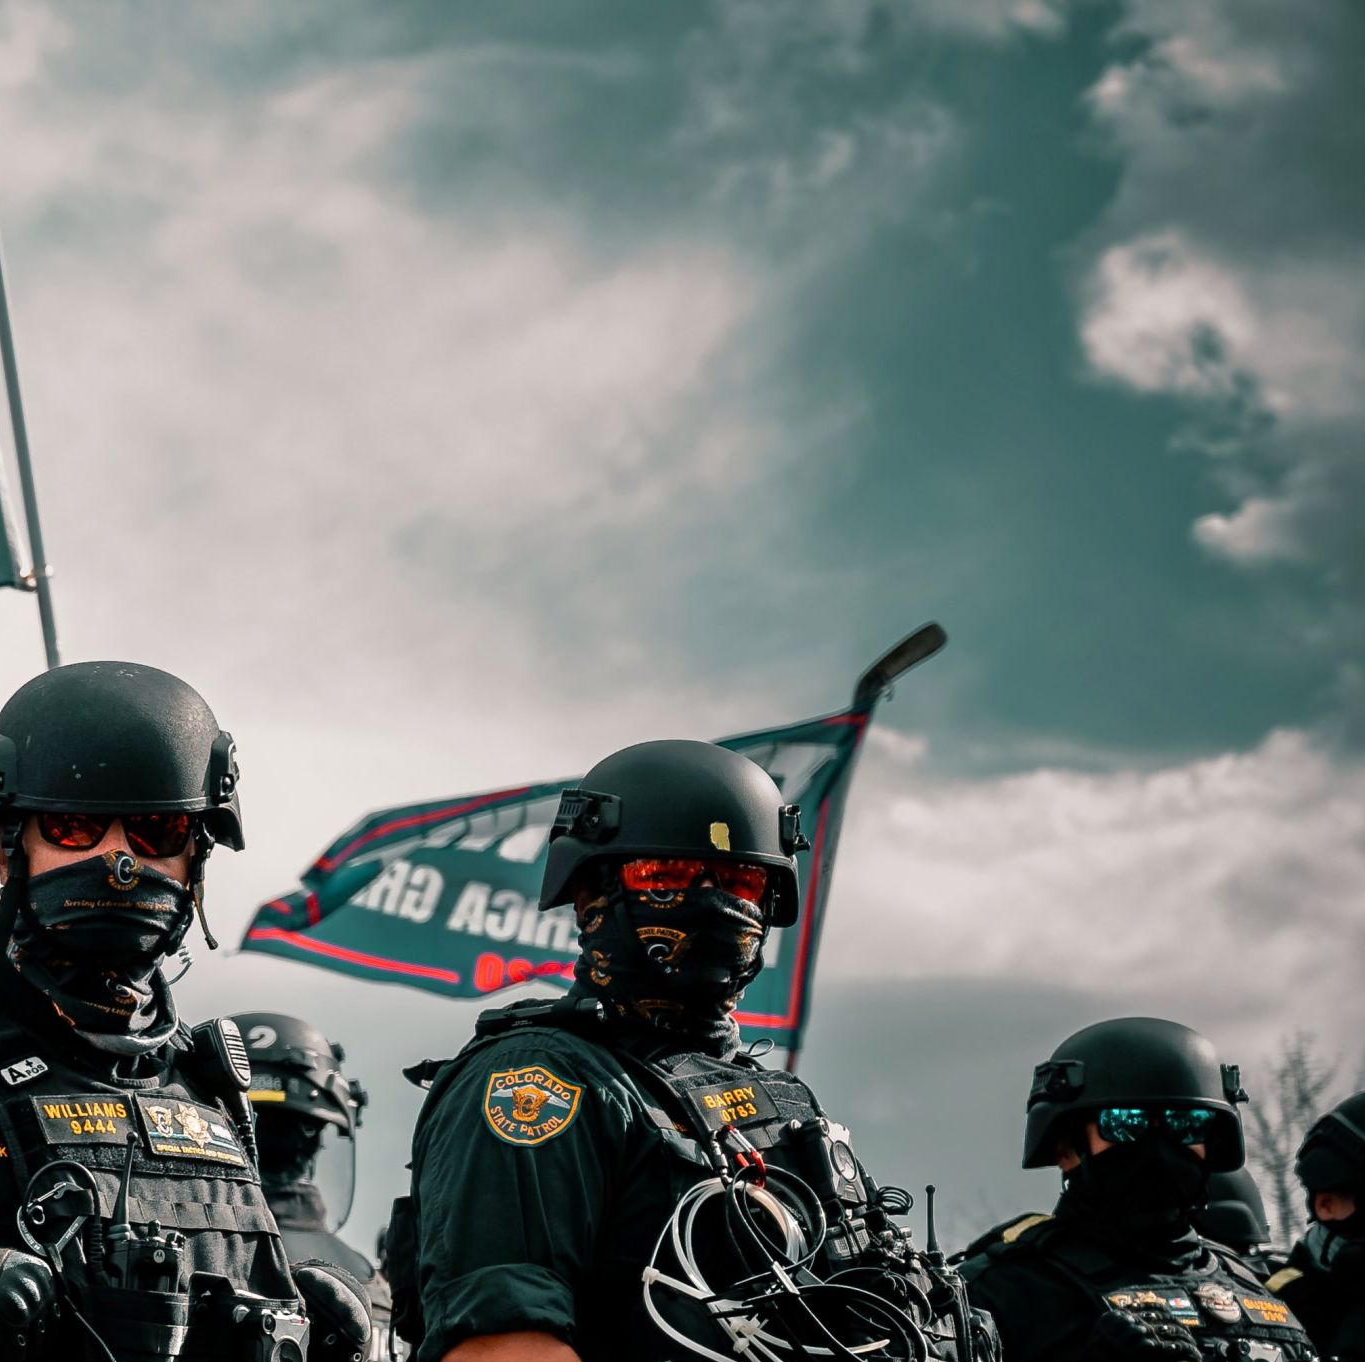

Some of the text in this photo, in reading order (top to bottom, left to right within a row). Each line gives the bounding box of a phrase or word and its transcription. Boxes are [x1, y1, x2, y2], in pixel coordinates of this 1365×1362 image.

[495, 1073, 572, 1101] COLORADO
[702, 1086, 755, 1109] BARRY
[43, 1102, 128, 1120] WILLIAMS
[491, 1106, 564, 1137] STATE PATROL
[720, 1102, 758, 1123] 0783
[69, 1118, 118, 1135] 9444
